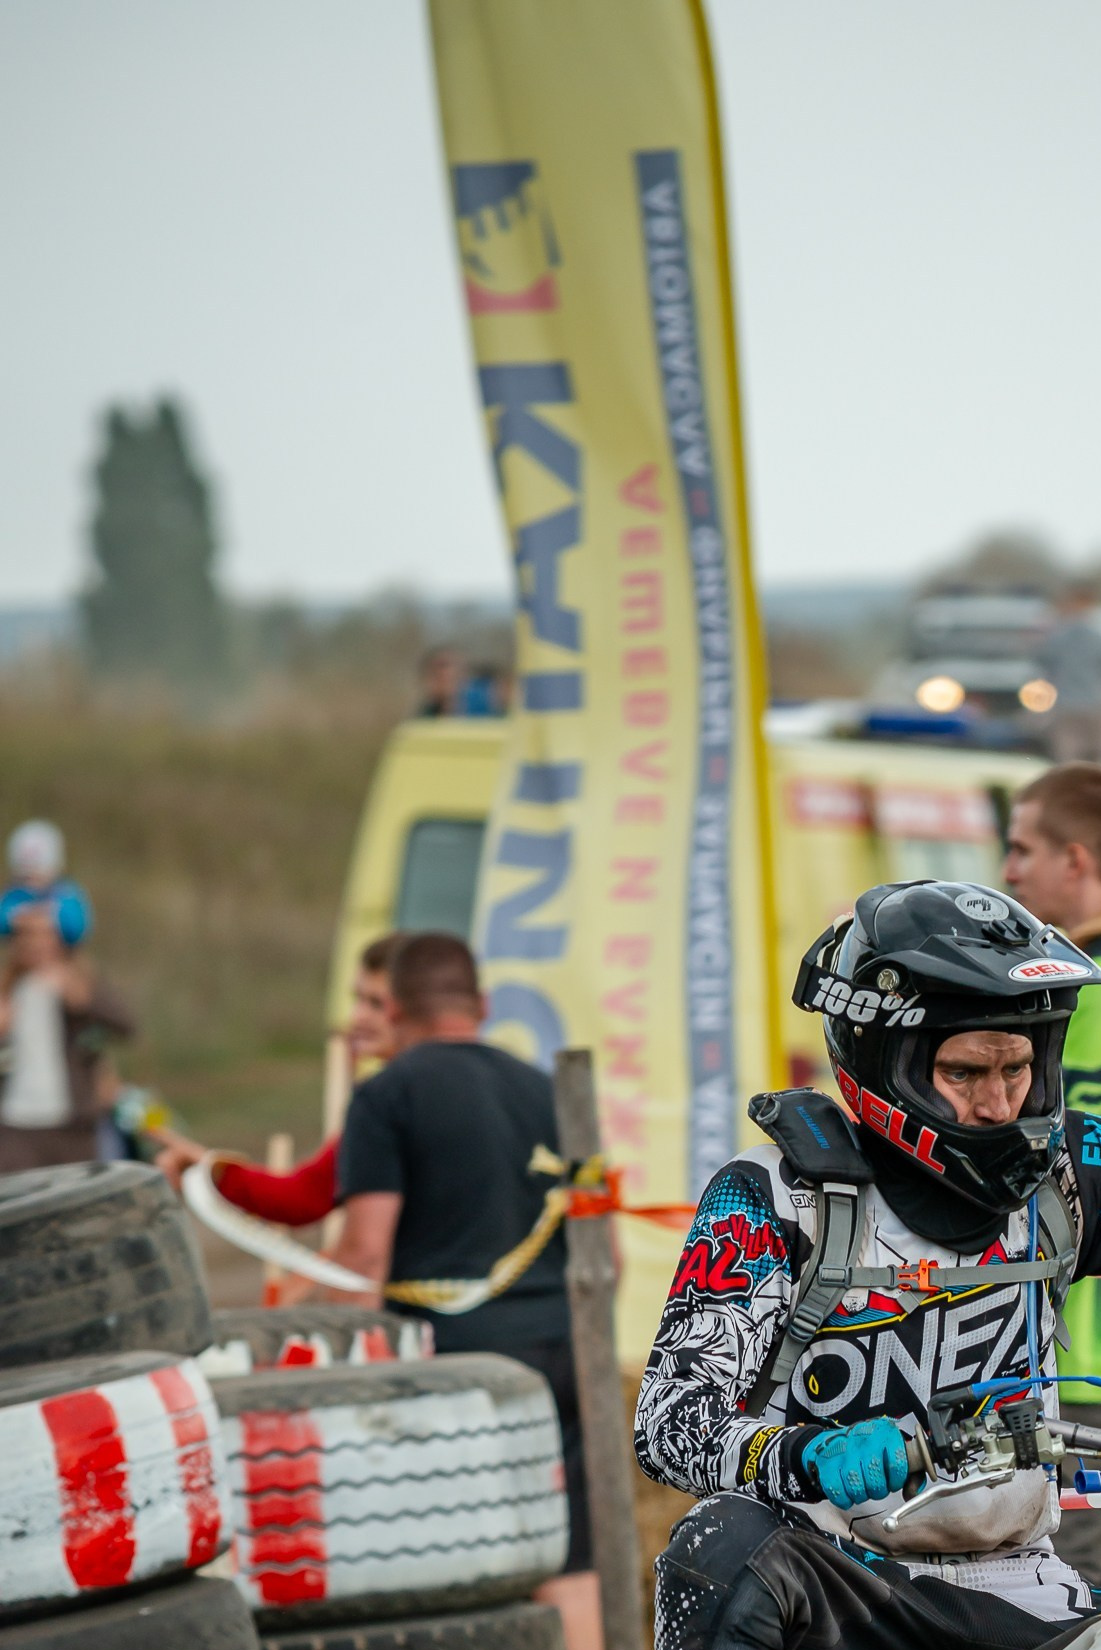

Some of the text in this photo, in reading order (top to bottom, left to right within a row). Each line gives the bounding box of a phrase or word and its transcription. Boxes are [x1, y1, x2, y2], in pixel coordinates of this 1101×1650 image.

[1020, 964, 1082, 977] BELL
[812, 976, 926, 1027] 100%
[837, 1064, 945, 1175] BELL
[712, 1220, 731, 1236] THE
[791, 1283, 1053, 1418] O'NEA
